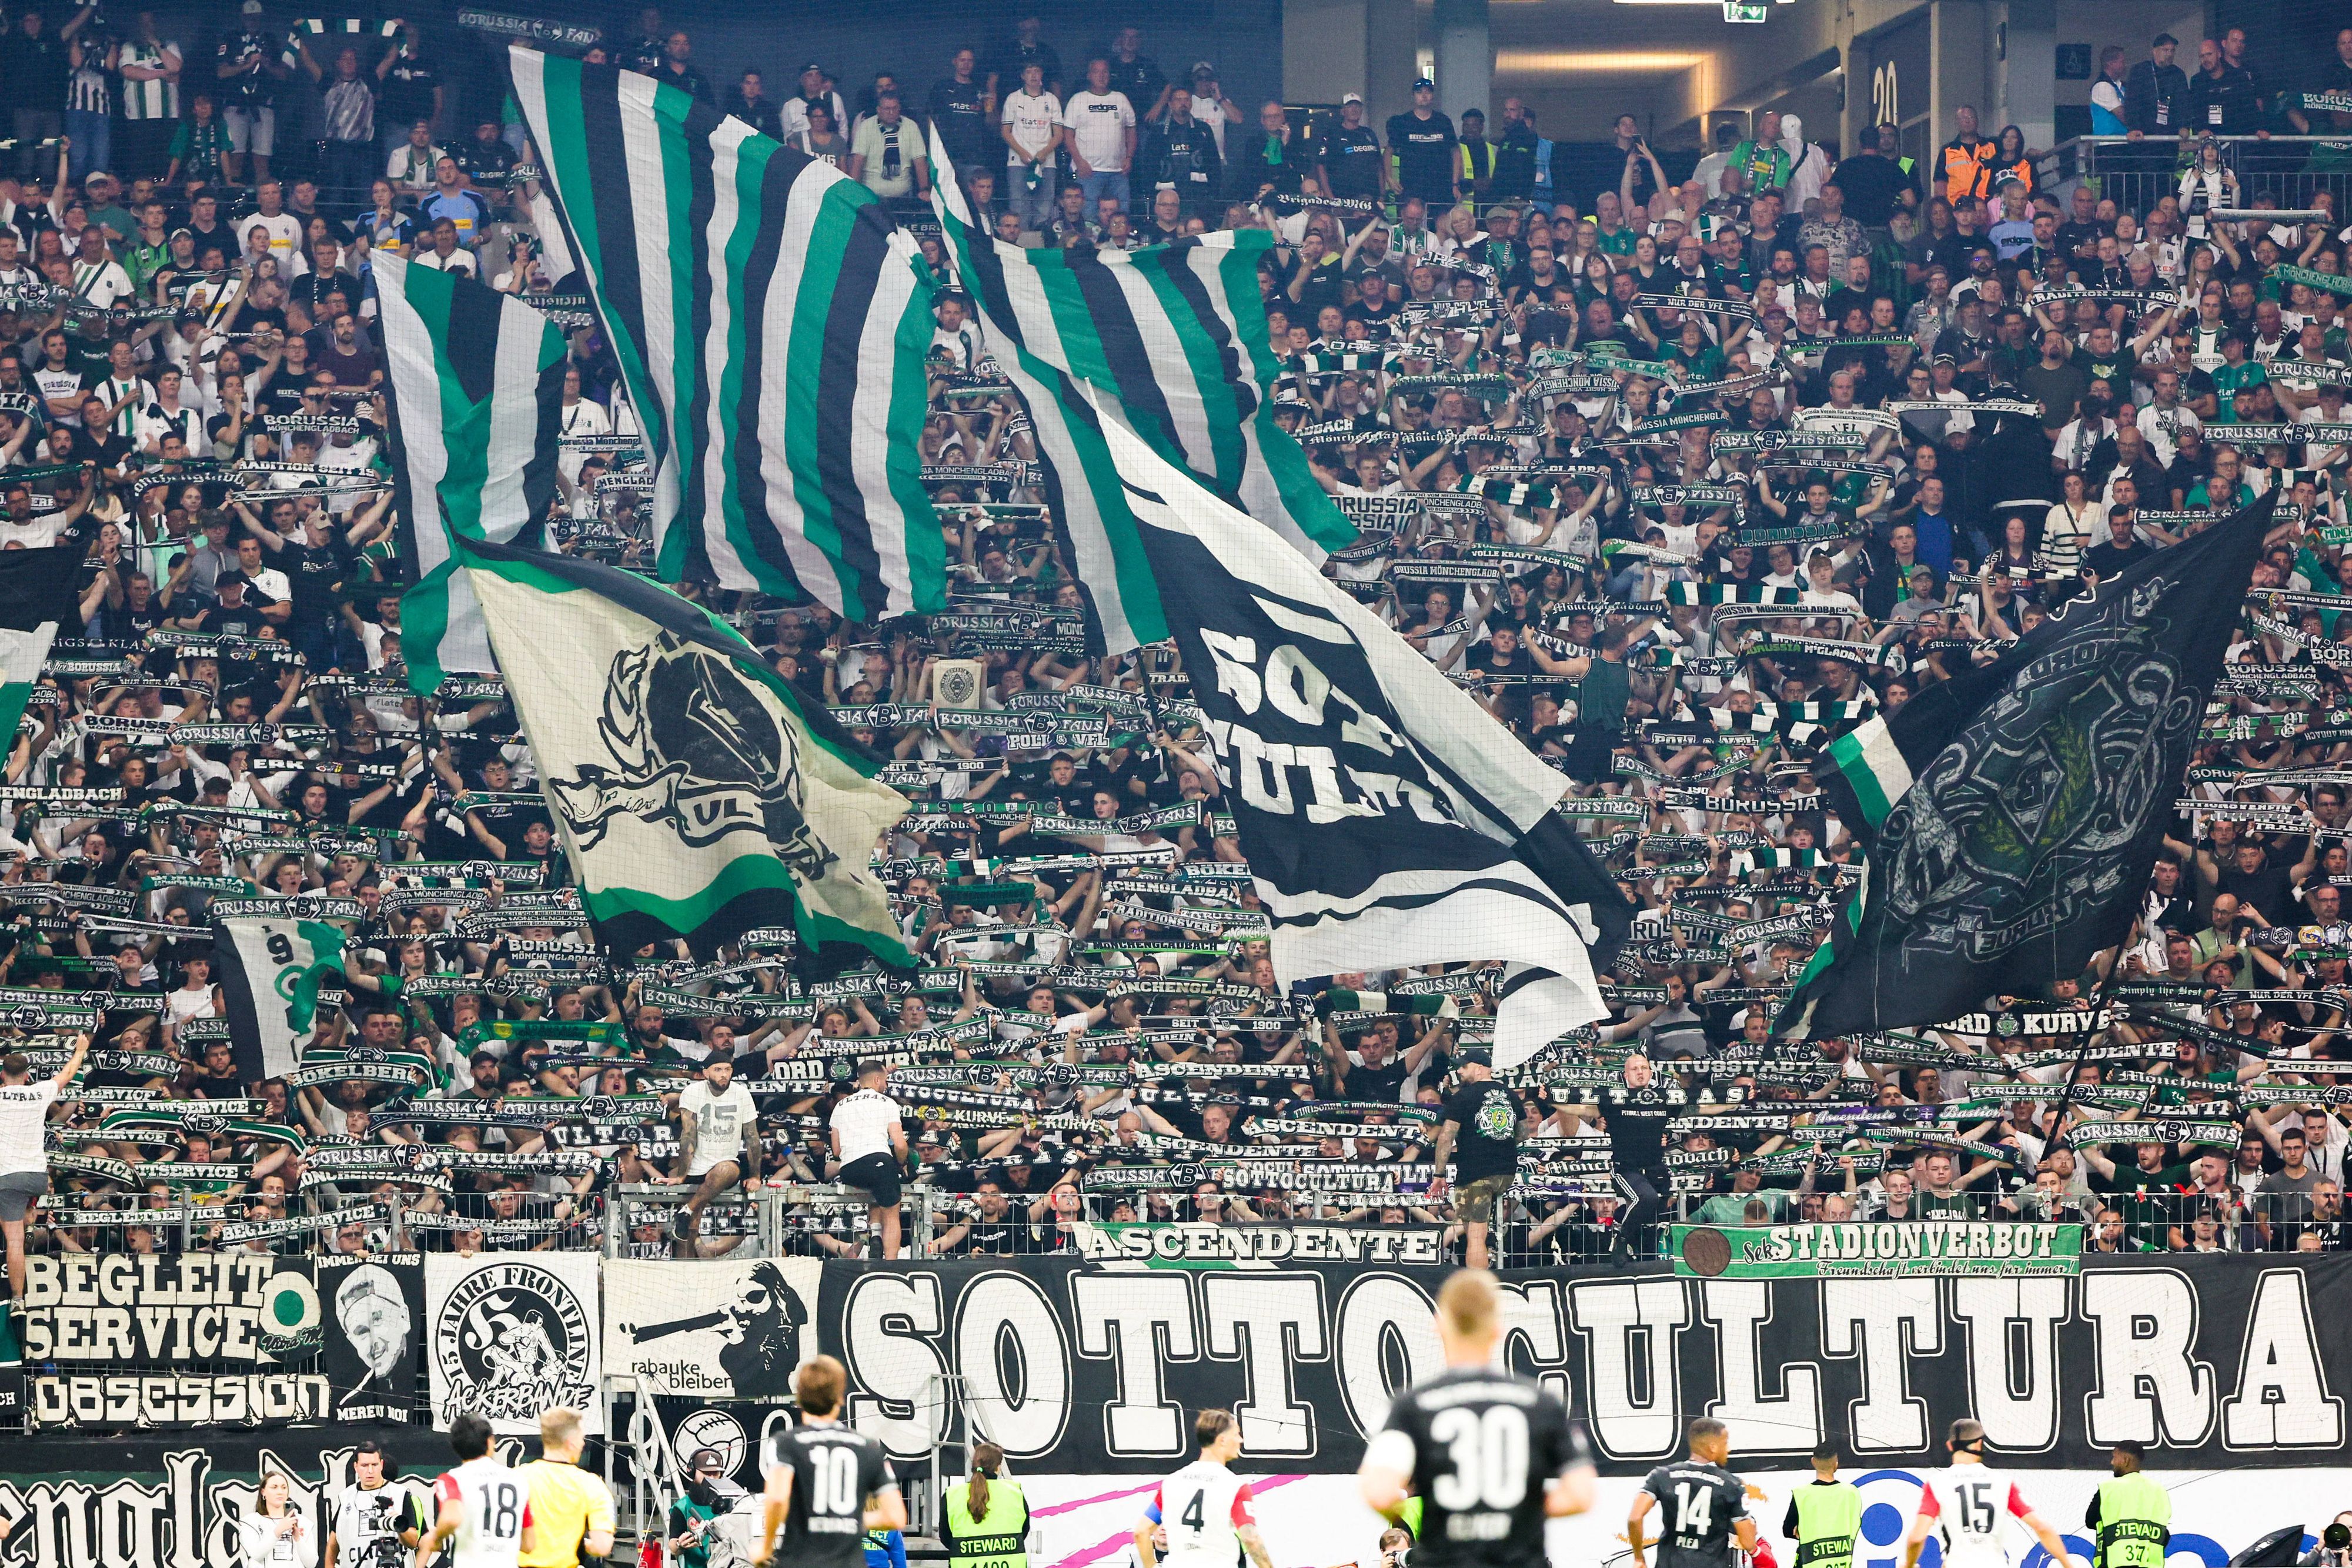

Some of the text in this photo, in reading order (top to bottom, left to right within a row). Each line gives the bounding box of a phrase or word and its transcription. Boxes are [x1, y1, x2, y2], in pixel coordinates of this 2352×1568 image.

[1873, 60, 1898, 127] 20
[1708, 302, 1723, 310] VFL
[263, 414, 359, 427] BORUSSIA
[2205, 426, 2278, 440] BORUSSIA
[84, 715, 170, 731] BORUSS
[940, 713, 1107, 731] BORUSSIA FANS
[957, 761, 984, 771] 1900
[1034, 805, 1196, 831] BORUSSIA FANS
[121, 994, 163, 1011] FANS
[2249, 991, 2314, 1001] NUR DER VFL
[51, 1012, 95, 1027] FANS
[771, 1003, 814, 1018] FANS
[1172, 1018, 1281, 1031] SEIT 1900
[136, 1055, 179, 1076] FANS
[1085, 1069, 1128, 1083] FANS
[2102, 1087, 2147, 1102] FANS
[2072, 1122, 2239, 1145] BORUSSIA FANS
[1222, 1168, 1395, 1193] SOTTOCULTURA
[1083, 1225, 1442, 1266] ASCENDENTE
[1769, 1223, 2057, 1261] STADIONVERBOT
[392, 1253, 420, 1266] UNS
[1816, 1260, 1910, 1279] Freundschaft
[1972, 1263, 1998, 1276] uns
[24, 1252, 275, 1308] BEGLEIT
[440, 1271, 497, 1343] JAHRE
[24, 1306, 259, 1360] SERVICE
[631, 1358, 700, 1375] rabauke
[669, 1372, 733, 1390] bleiben
[442, 1375, 594, 1423] ACKERBANDE
[1429, 1405, 1529, 1511] 30
[811, 1445, 859, 1514] 10
[478, 1483, 519, 1538] 18
[1181, 1488, 1205, 1538] 4
[1675, 1482, 1712, 1536] 14
[1954, 1482, 1996, 1534] 15
[959, 1536, 1017, 1555] STEWARD
[1812, 1538, 1852, 1557] STEWA
